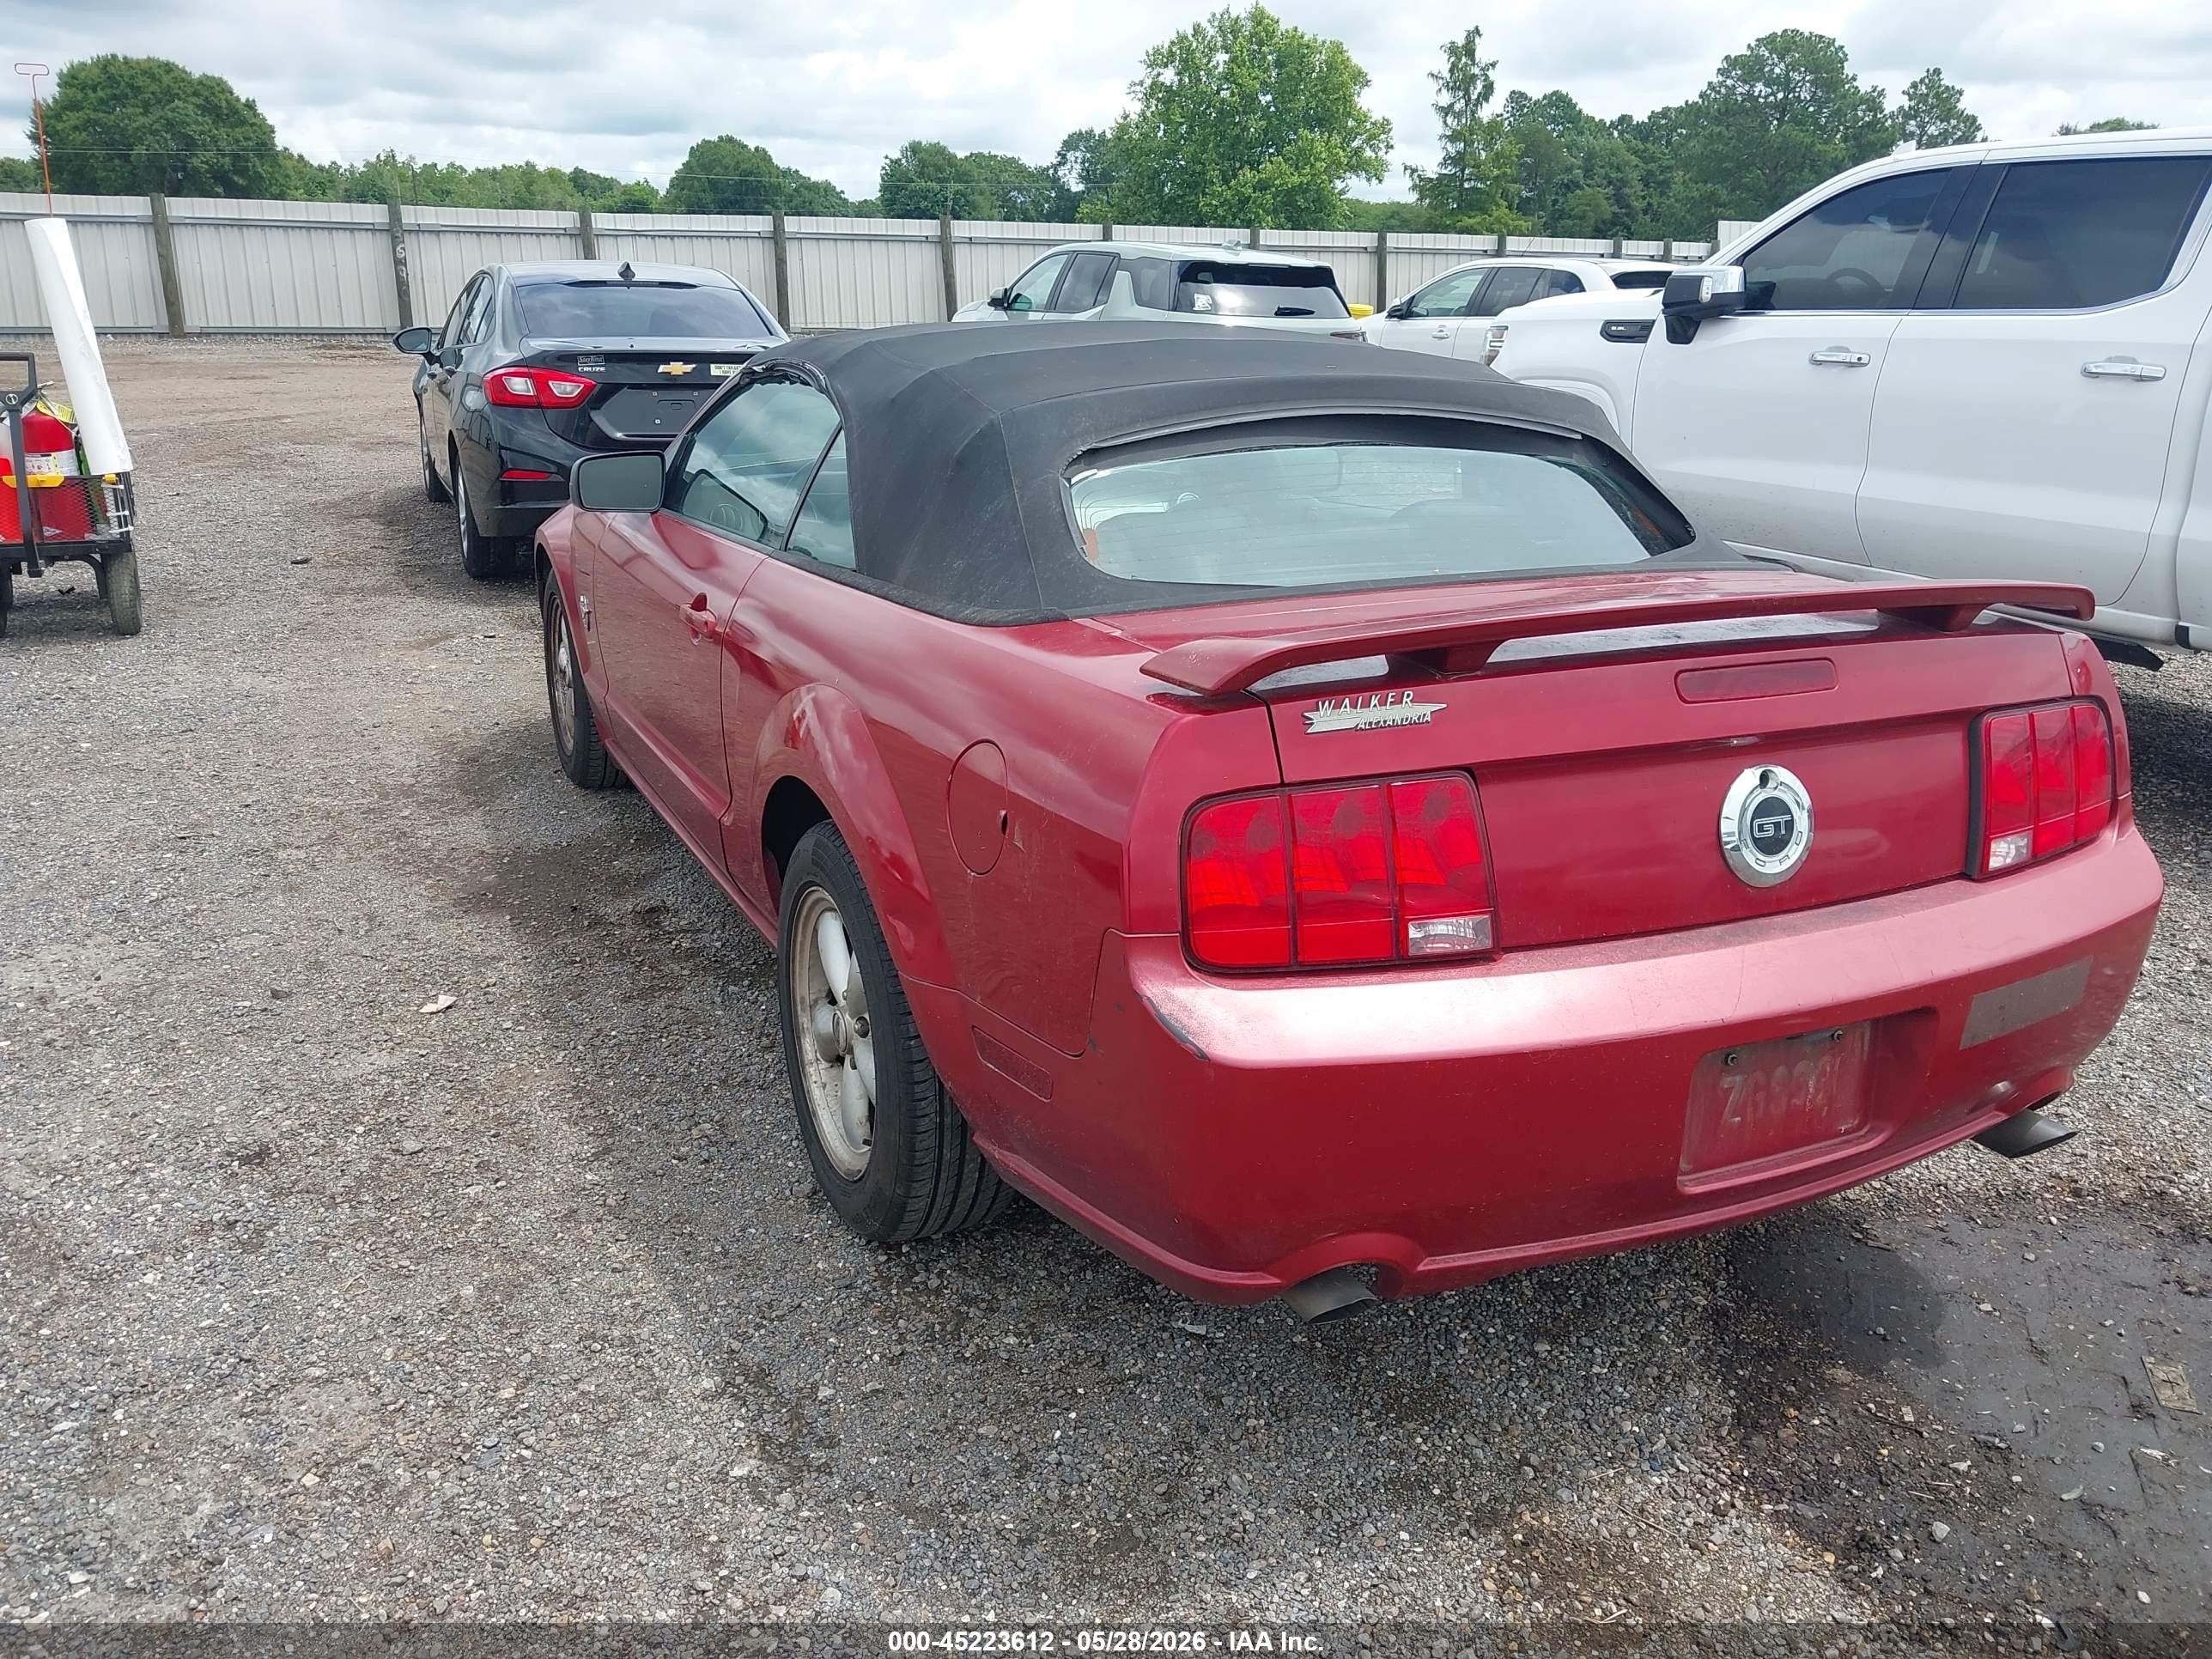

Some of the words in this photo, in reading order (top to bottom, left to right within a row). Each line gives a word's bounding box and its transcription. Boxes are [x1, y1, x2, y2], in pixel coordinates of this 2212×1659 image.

[1318, 691, 1415, 717] WALKER
[1357, 711, 1432, 731] ALEXANDRIA
[1753, 815, 1792, 838] GT
